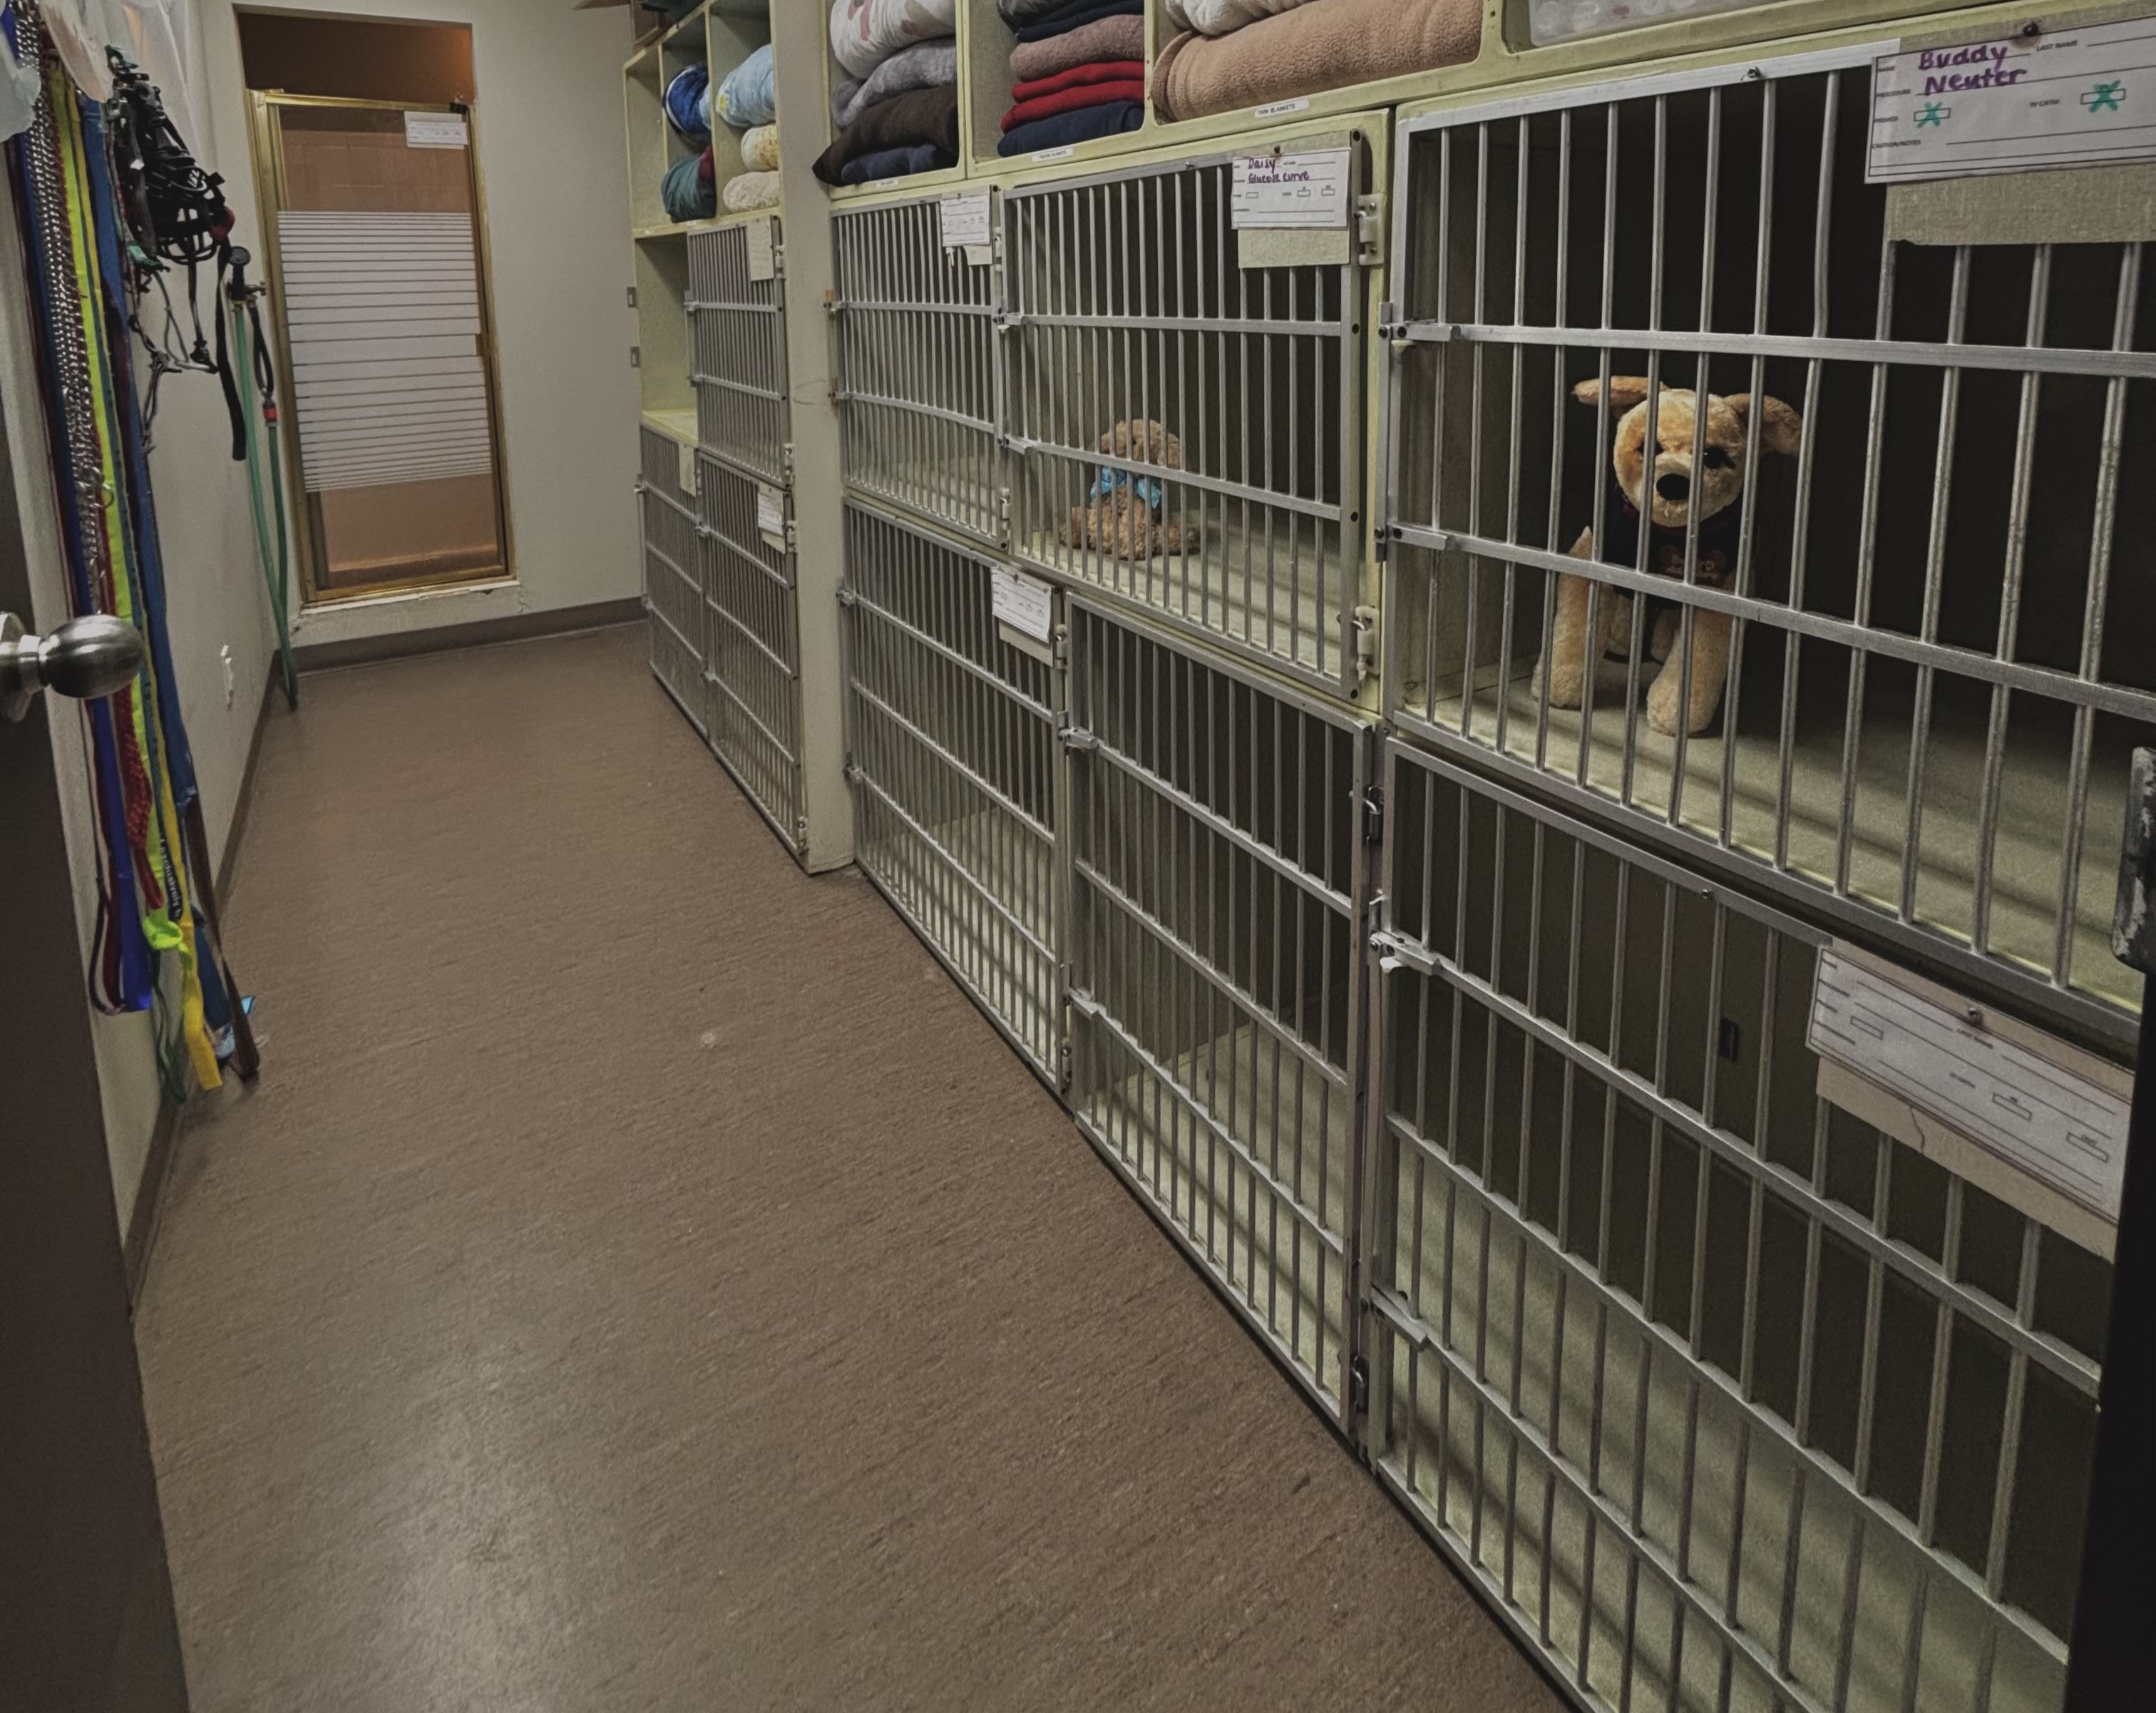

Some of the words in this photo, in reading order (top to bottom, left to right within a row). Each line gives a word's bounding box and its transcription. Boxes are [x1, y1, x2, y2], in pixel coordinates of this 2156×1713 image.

[1919, 45, 2008, 71] Buddy
[1924, 68, 2028, 96] Neuter
[1248, 158, 1276, 174] Daisy
[1248, 172, 1281, 184] Glucose
[1283, 170, 1310, 182] curve
